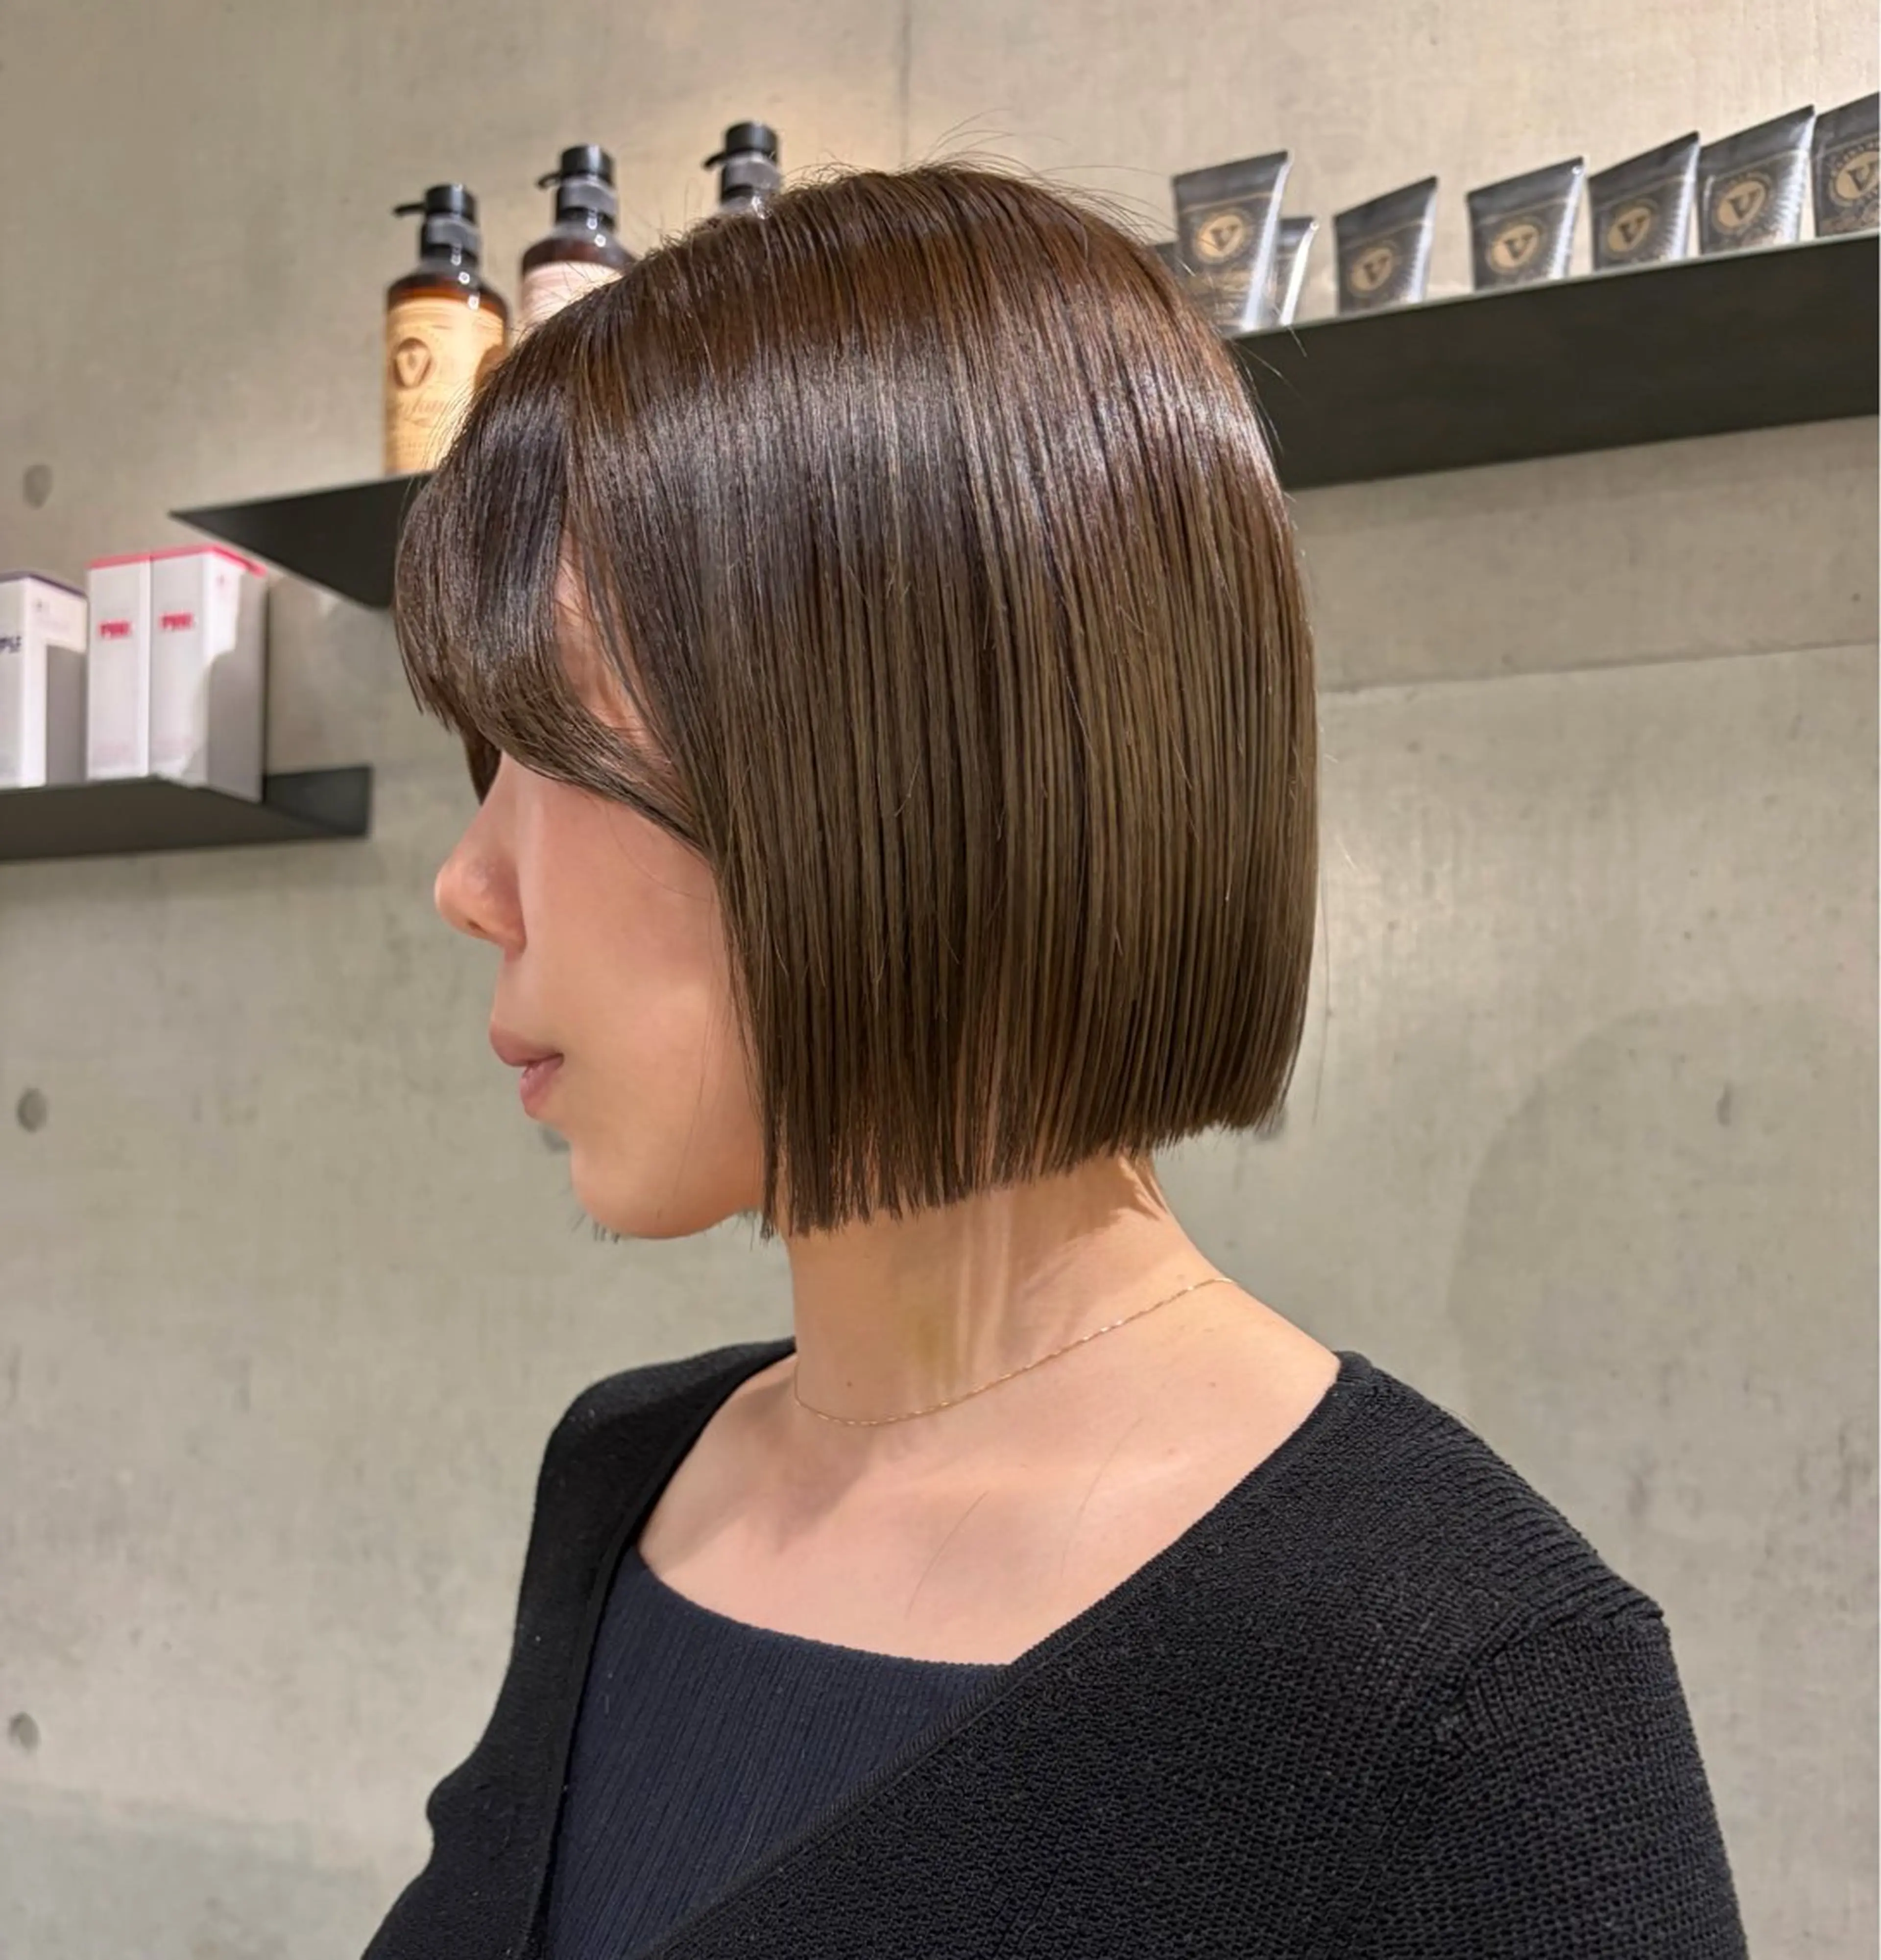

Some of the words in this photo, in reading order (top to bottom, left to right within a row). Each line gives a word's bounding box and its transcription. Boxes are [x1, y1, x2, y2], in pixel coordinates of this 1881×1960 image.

[1846, 160, 1879, 191] V
[1726, 188, 1761, 220] V
[1209, 223, 1238, 251] V
[1618, 214, 1646, 244] V
[1503, 232, 1533, 260] V
[1363, 255, 1390, 286] V
